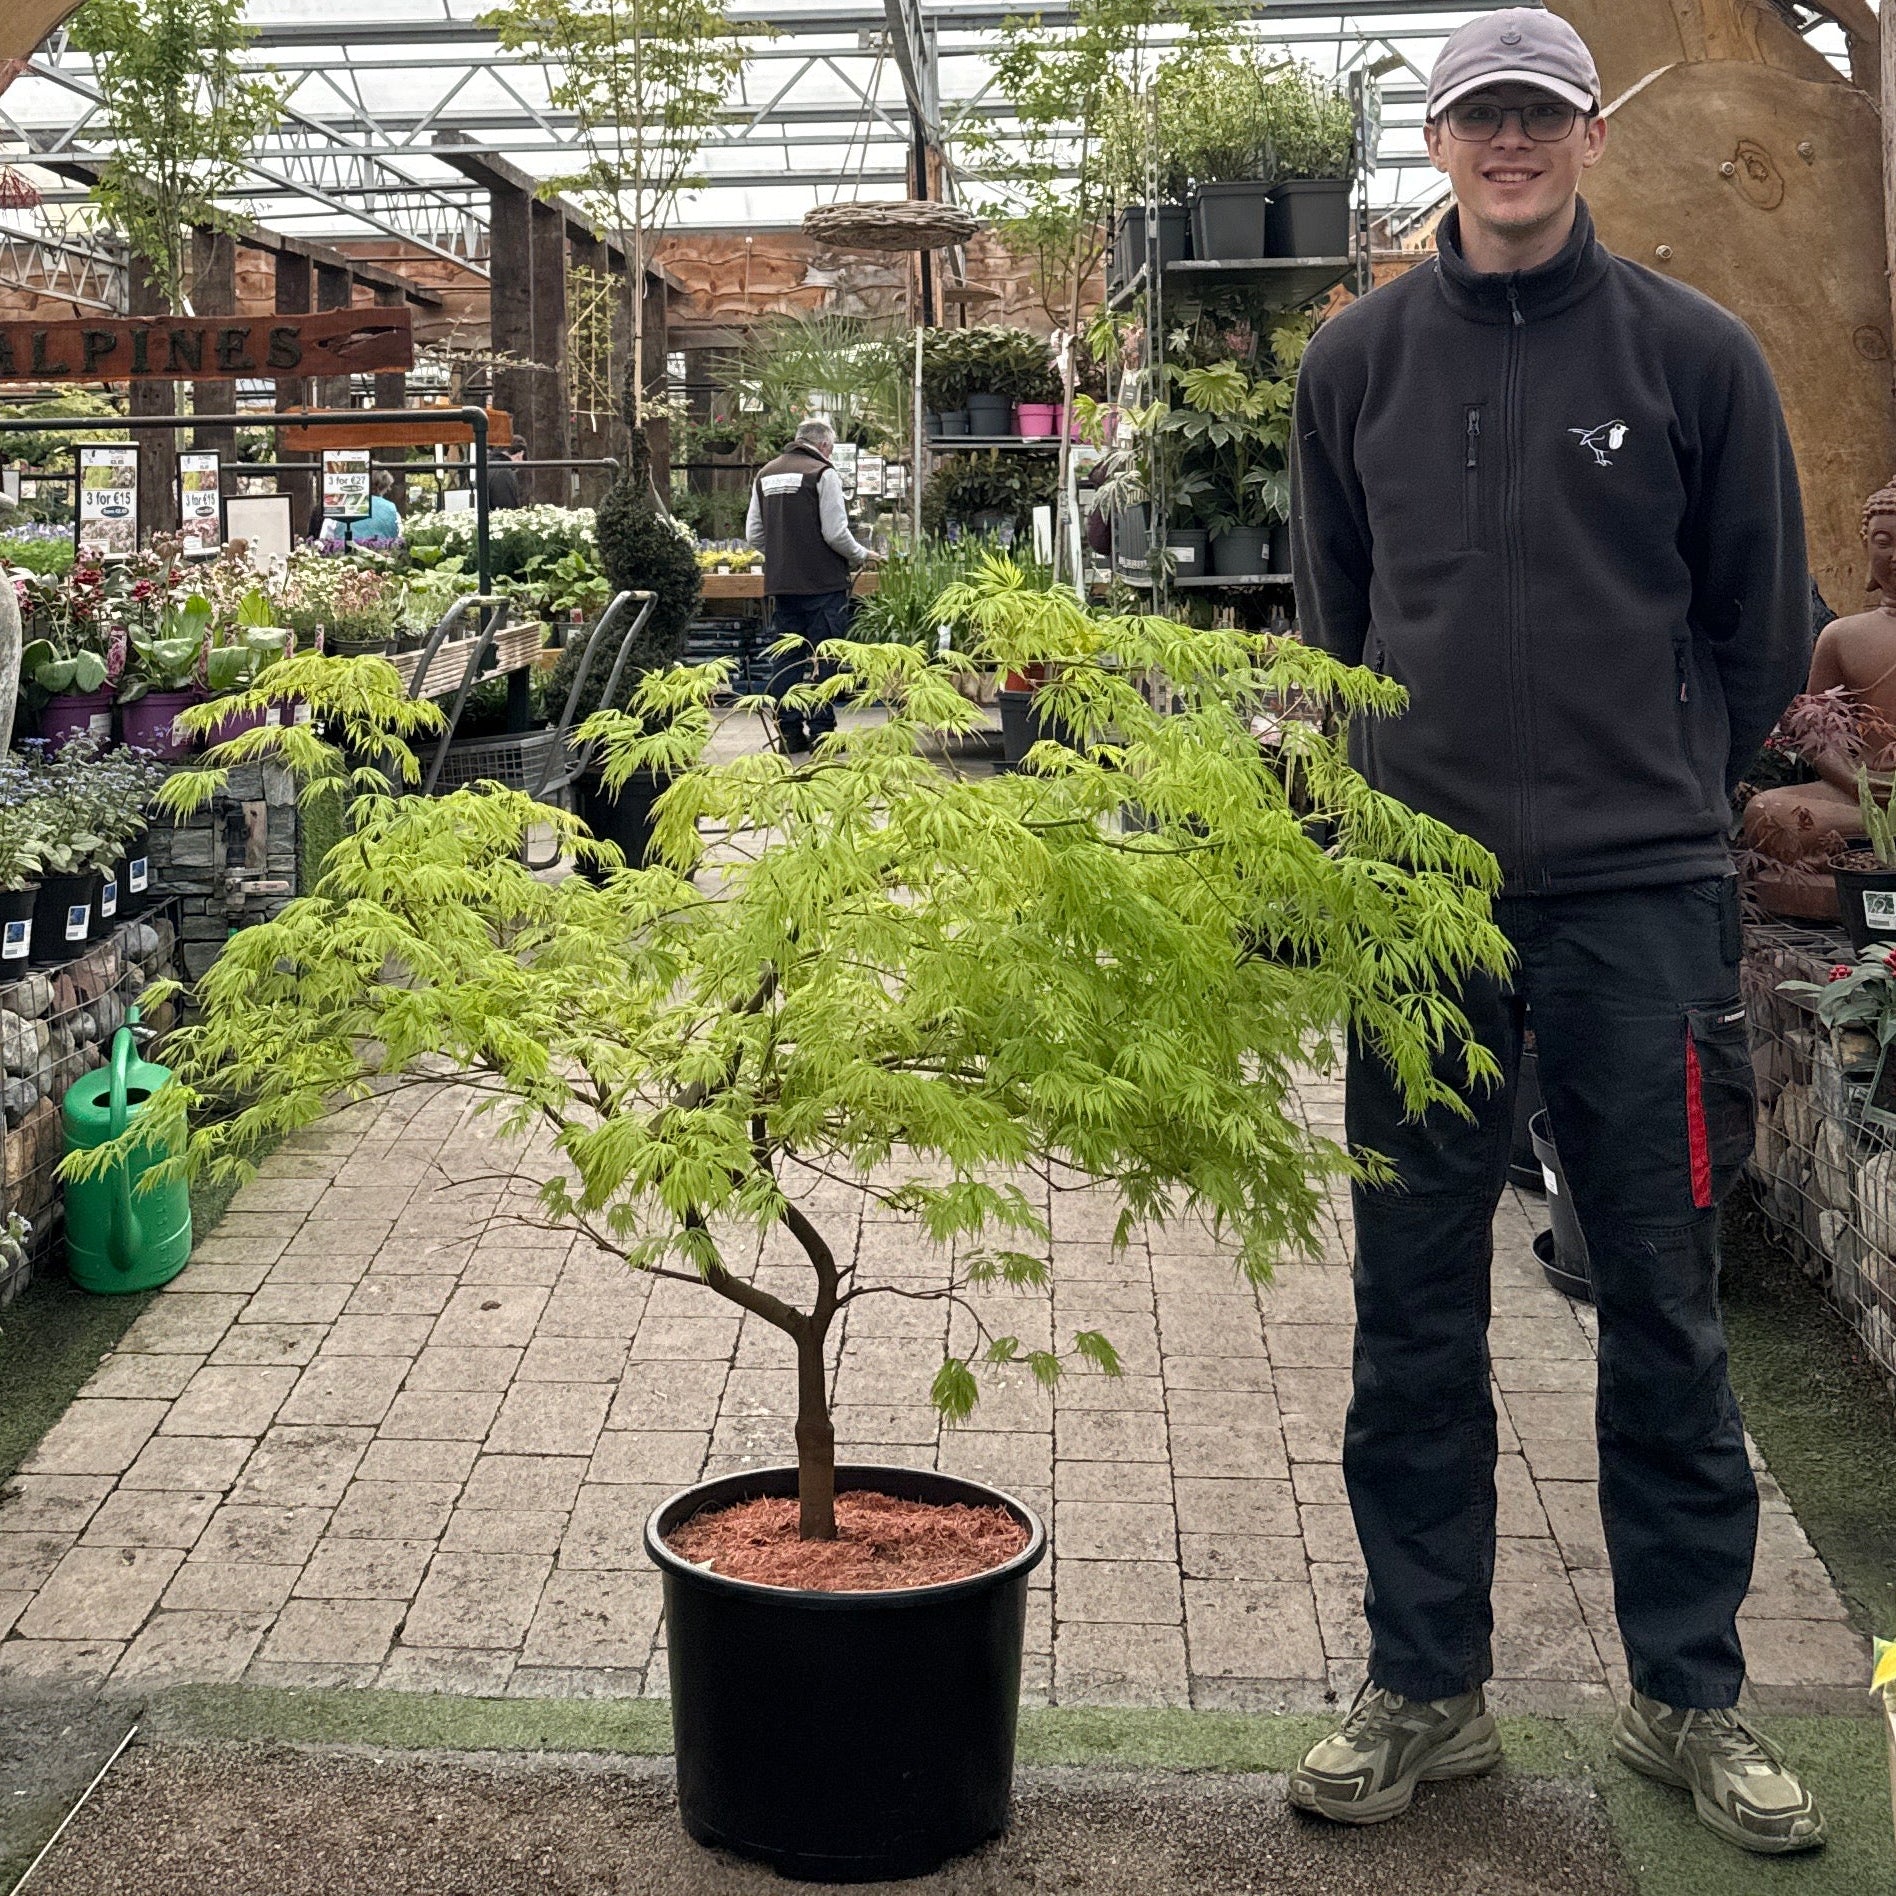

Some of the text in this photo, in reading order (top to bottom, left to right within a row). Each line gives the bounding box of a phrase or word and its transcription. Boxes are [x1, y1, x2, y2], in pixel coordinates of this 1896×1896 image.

[328, 476, 333, 485] 3
[336, 476, 348, 485] for
[86, 491, 131, 506] 3 for €15
[185, 494, 190, 507] 3
